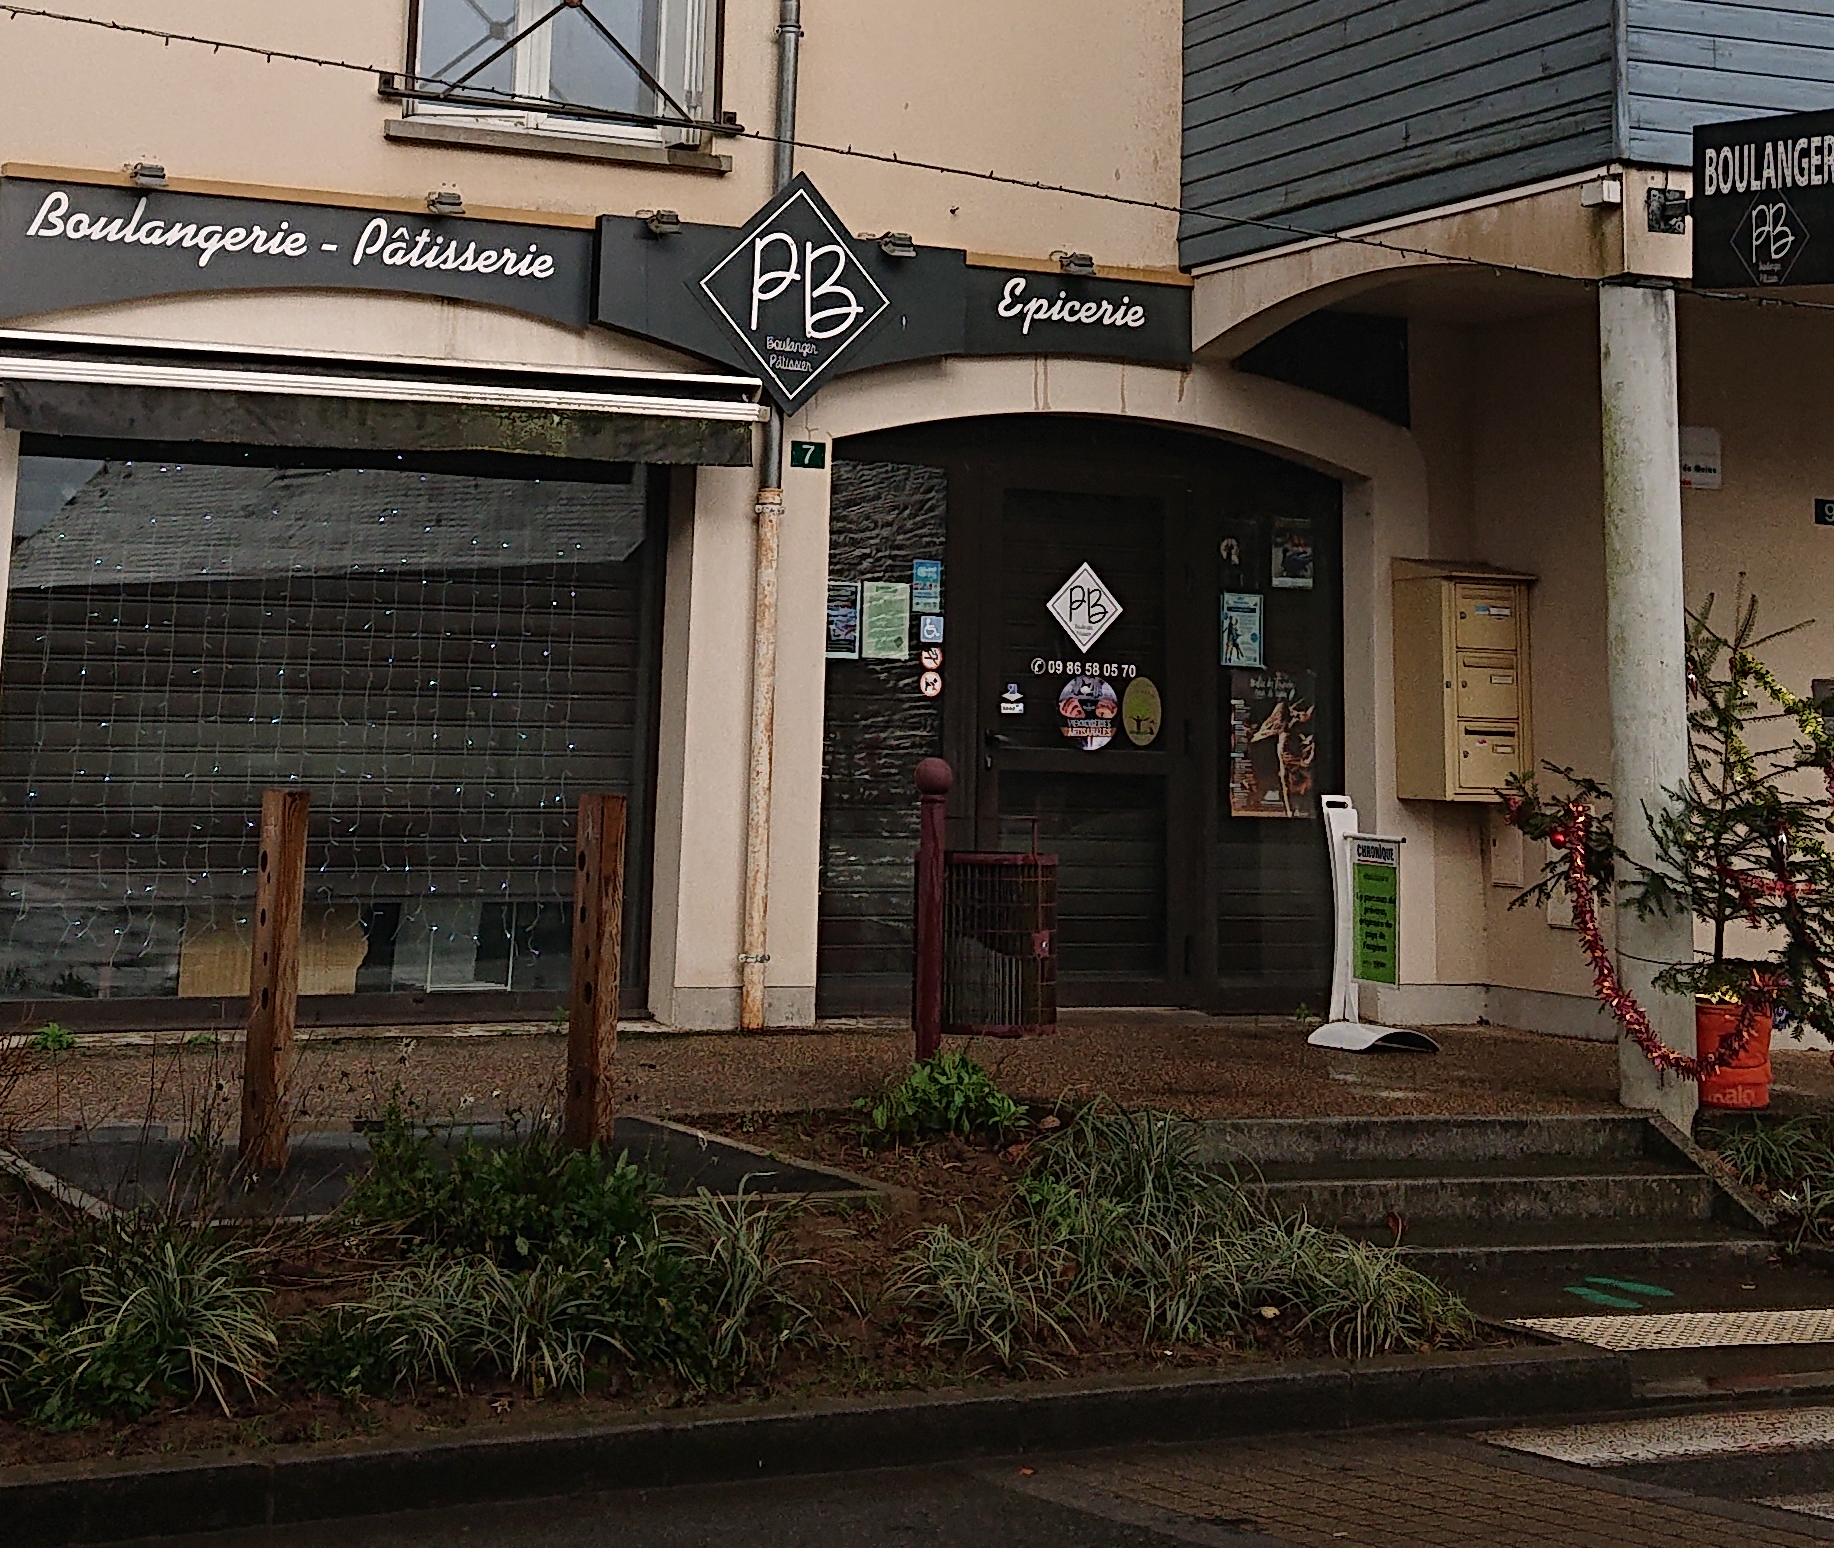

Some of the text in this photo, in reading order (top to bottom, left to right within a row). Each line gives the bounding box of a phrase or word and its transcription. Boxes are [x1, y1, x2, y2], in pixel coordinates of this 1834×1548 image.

[26, 191, 308, 267] Boulangerie
[353, 216, 555, 281] Pâtisserie
[1751, 201, 1796, 264] PB
[749, 231, 865, 340] PB
[996, 276, 1146, 335] Epicerie
[765, 336, 819, 357] Boulanger
[801, 444, 816, 465] 7
[1068, 585, 1108, 624] PB
[1048, 660, 1137, 678] 09 86 58 05 70
